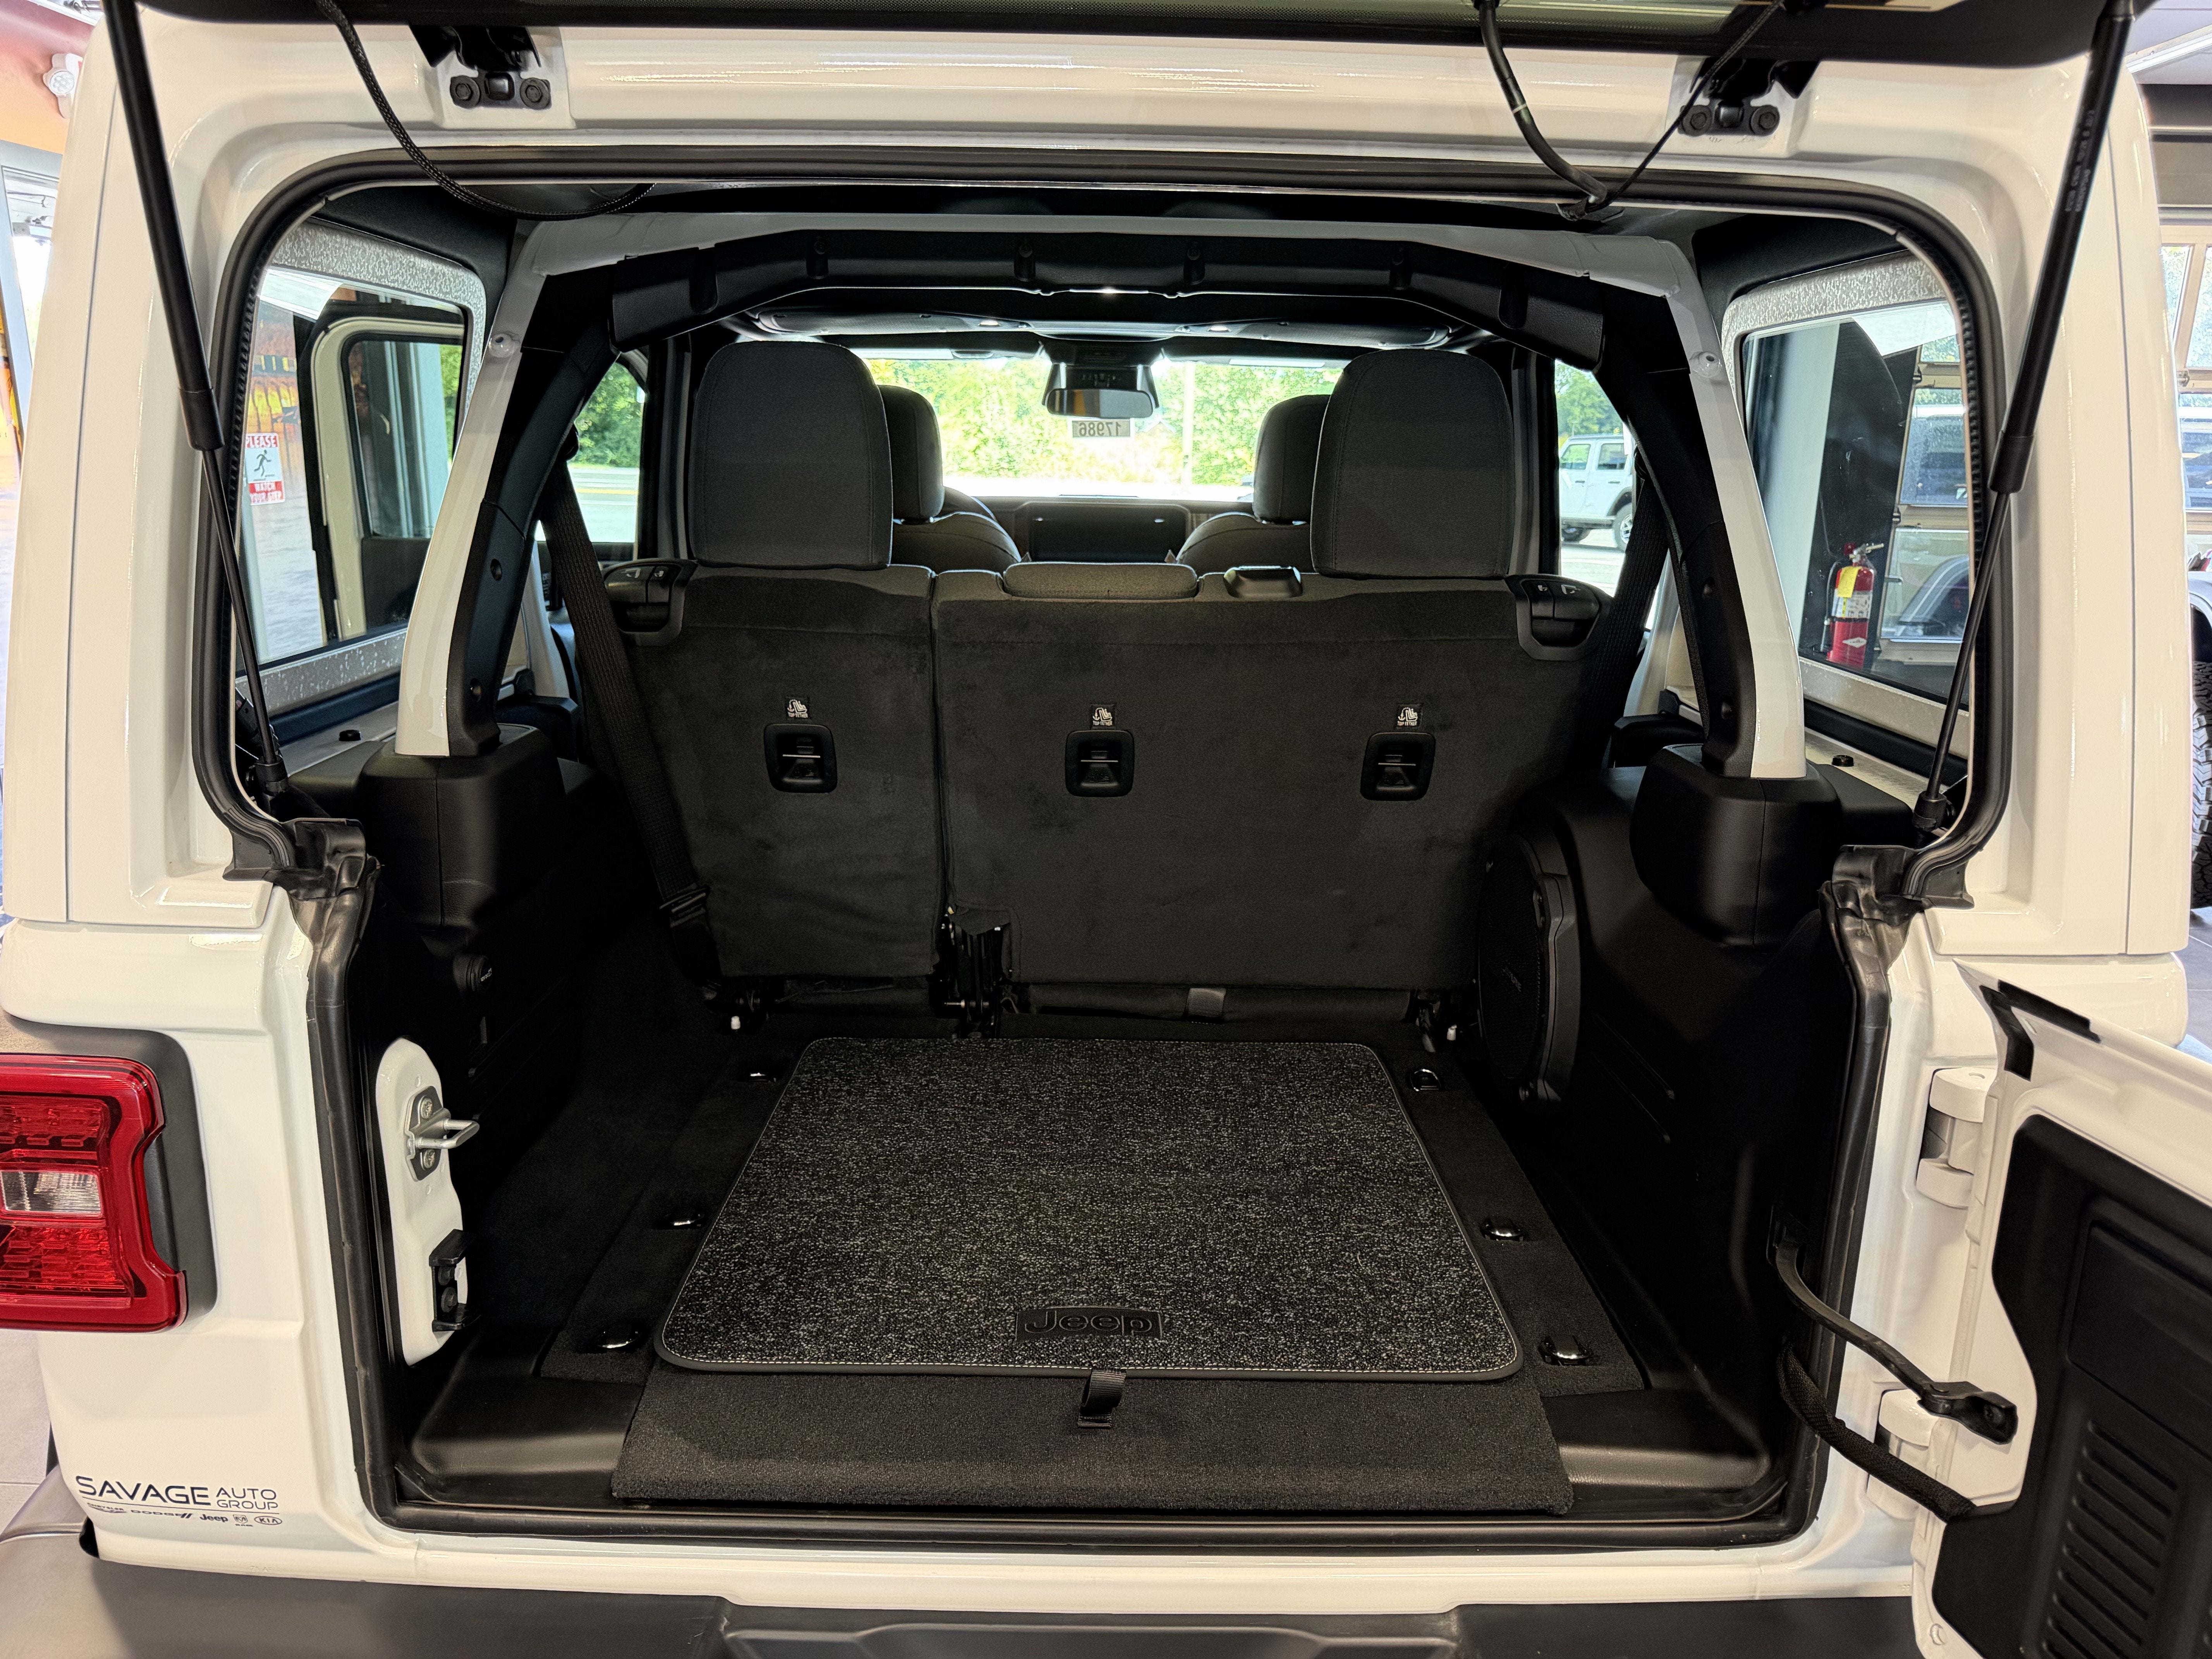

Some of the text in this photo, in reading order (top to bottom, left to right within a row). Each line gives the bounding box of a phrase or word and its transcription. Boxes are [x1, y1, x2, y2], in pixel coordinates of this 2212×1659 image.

[246, 435, 277, 448] PLEASE
[1024, 1310, 1152, 1336] Jeep
[76, 1475, 277, 1506] SAVAGE AUTO
[87, 1503, 124, 1511] CHRYSLER
[199, 1514, 228, 1523] Jeep
[216, 1499, 279, 1510] GROUP
